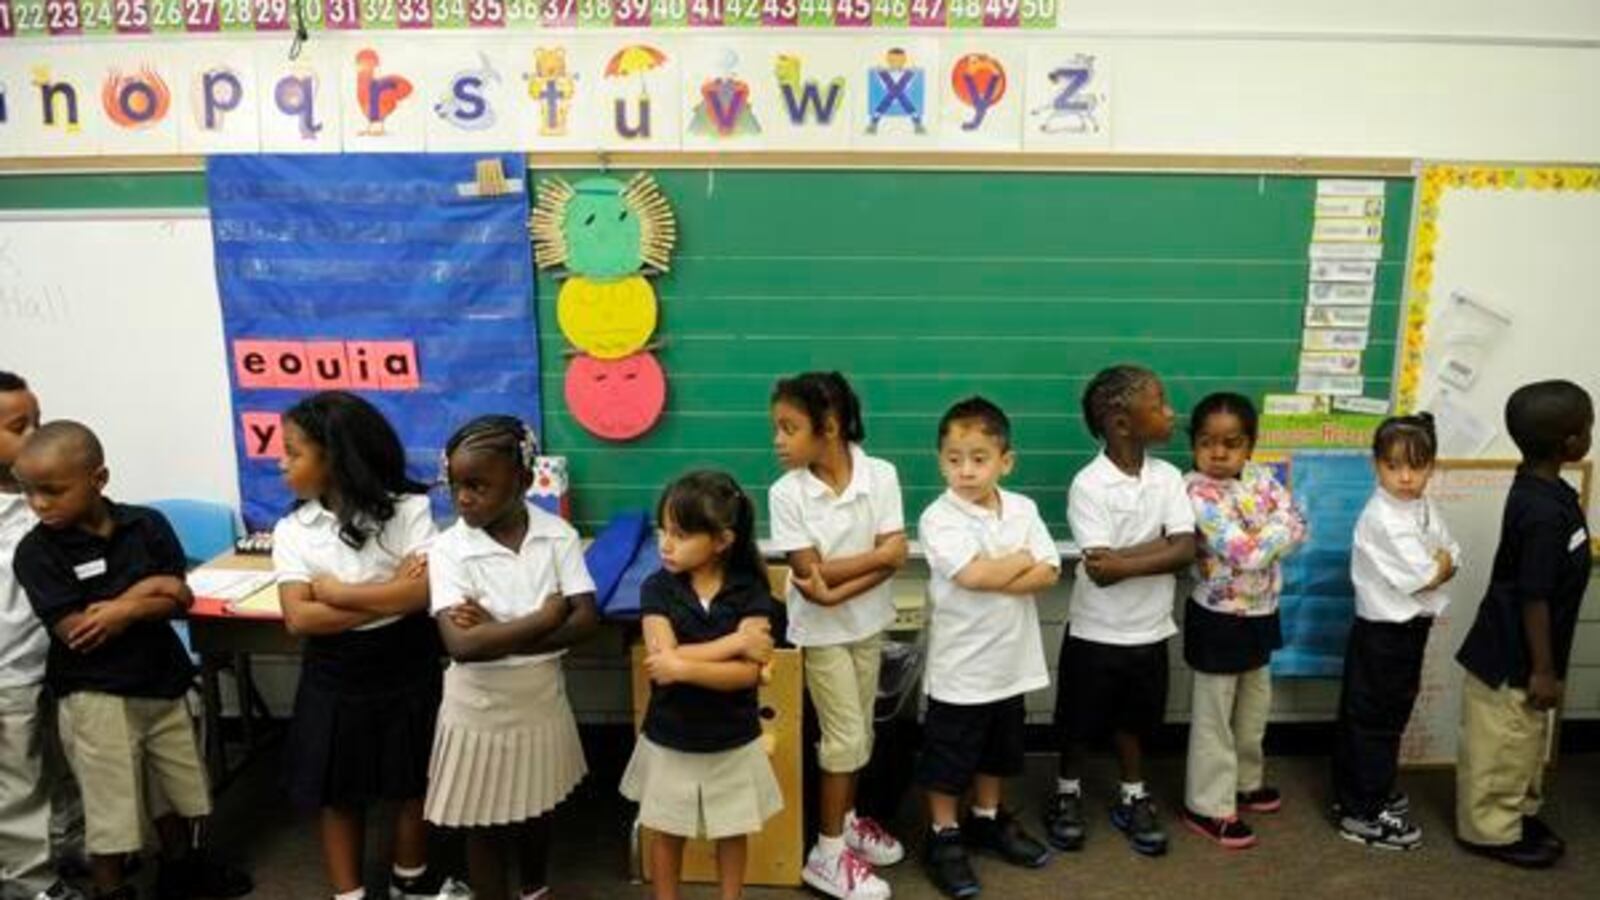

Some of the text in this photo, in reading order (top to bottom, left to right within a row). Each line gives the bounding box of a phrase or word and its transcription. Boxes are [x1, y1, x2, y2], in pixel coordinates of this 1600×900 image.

[17, 5, 44, 28] 22
[50, 3, 78, 28] 23
[82, 2, 111, 27] 24
[118, 1, 148, 25] 25
[154, 0, 182, 25] 26
[187, 0, 214, 24] 27
[222, 0, 251, 23] 28
[257, 0, 286, 22] 29
[330, 0, 356, 22] 31
[365, 0, 394, 21] 32
[400, 0, 430, 21] 33
[435, 0, 465, 21] 34
[471, 0, 502, 20] 35
[507, 0, 538, 19] 36
[544, 0, 573, 19] 37
[580, 0, 611, 19] 38
[617, 0, 648, 19] 39
[653, 0, 685, 18] 40
[692, 0, 721, 18] 41
[726, 0, 757, 18] 42
[763, 0, 796, 18] 43
[799, 0, 832, 18] 44
[837, 0, 870, 18] 45
[875, 0, 906, 17] 46
[912, 0, 943, 18] 47
[951, 0, 981, 18] 48
[985, 0, 1016, 18] 49
[1022, 0, 1053, 18] 50
[42, 80, 78, 125] n
[120, 82, 155, 121] o
[203, 71, 243, 129] p
[274, 76, 323, 139] q
[368, 75, 399, 122] r
[540, 80, 564, 128] t
[614, 97, 651, 139] u
[251, 424, 278, 455] y
